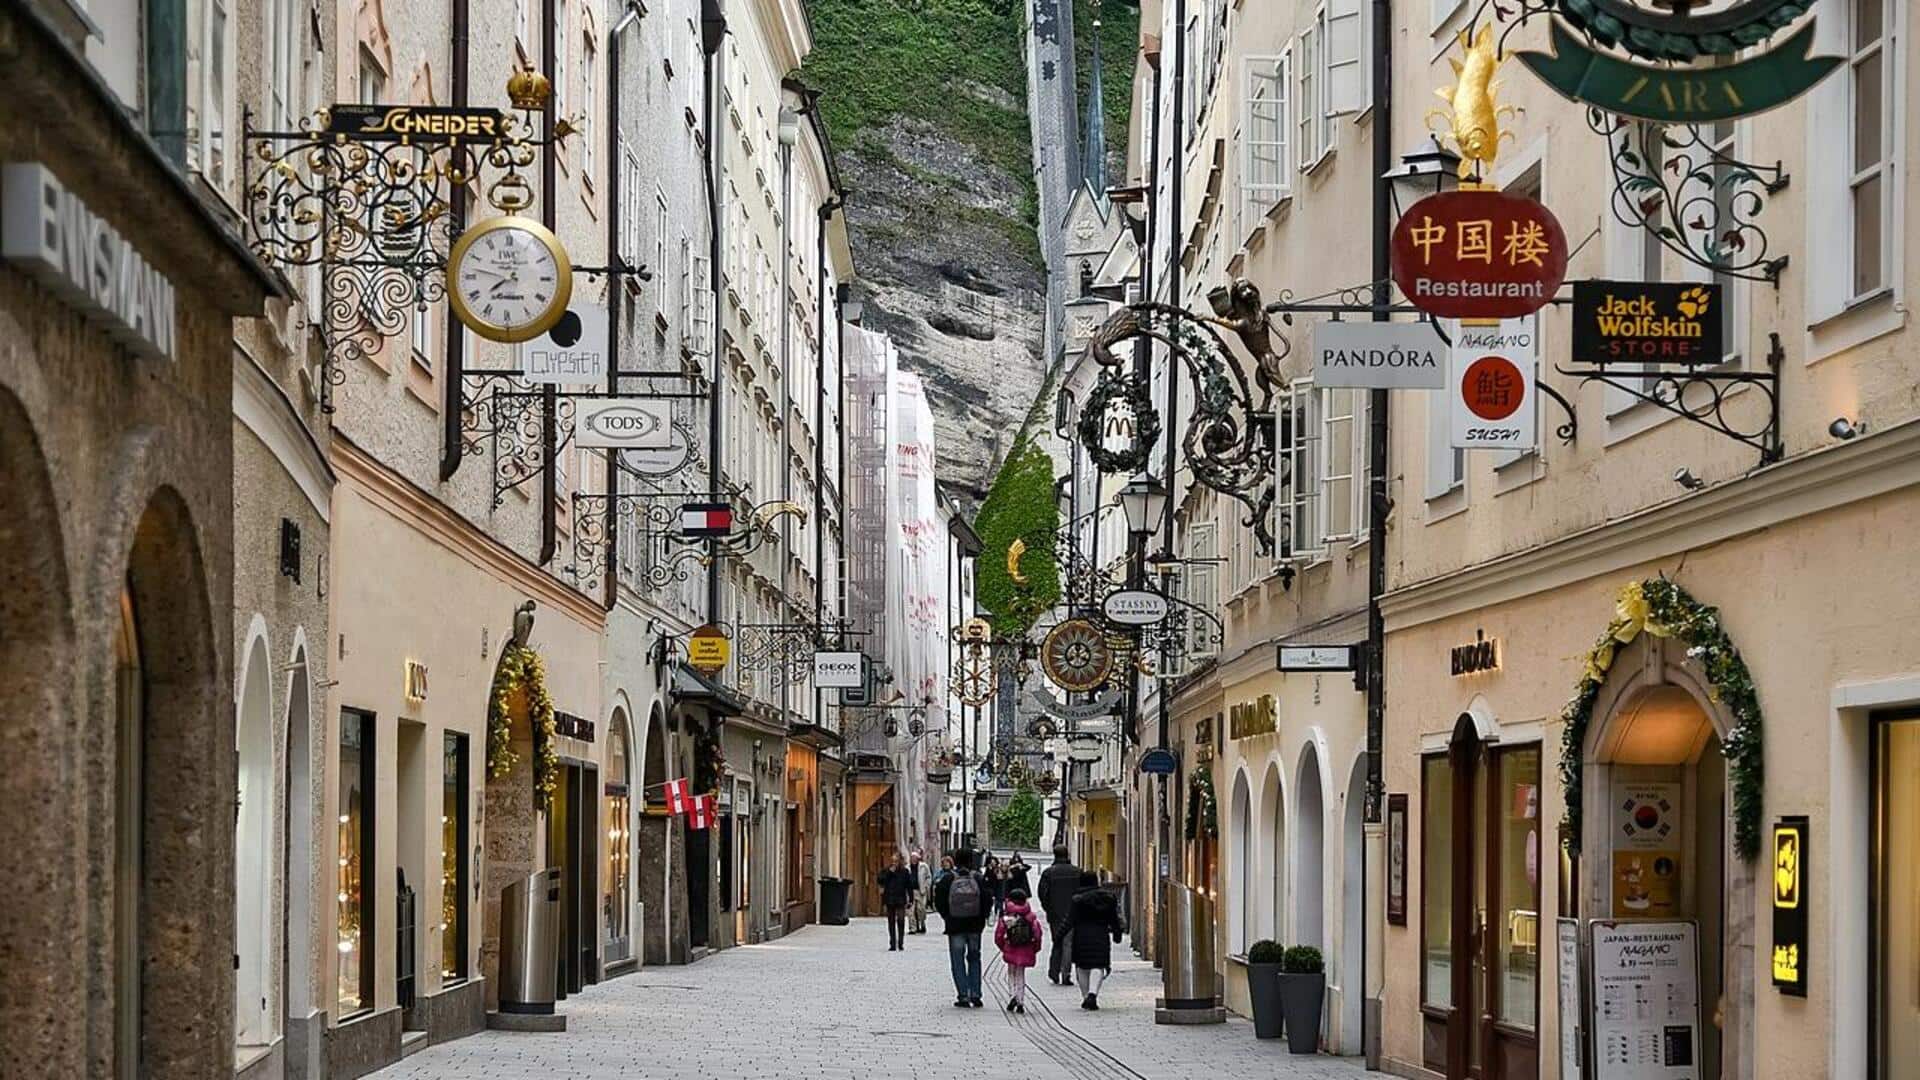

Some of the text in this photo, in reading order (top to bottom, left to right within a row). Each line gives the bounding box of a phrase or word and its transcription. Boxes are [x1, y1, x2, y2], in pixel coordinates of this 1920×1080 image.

[1620, 75, 1744, 112] ZARA
[360, 107, 496, 136] SCHNEIDER
[1409, 215, 1551, 267] 中国楼
[1415, 278, 1544, 297] Restaurant
[1598, 294, 1655, 316] Jack
[1597, 316, 1702, 337] Wolfskin
[1458, 333, 1531, 350] NAGANO
[1323, 345, 1436, 367] PANDORA
[1465, 428, 1521, 442] SUSHI
[1112, 600, 1159, 609] STASSNY
[819, 663, 857, 671] GEOX
[1603, 934, 1686, 943] JAPAN-RESTAURANT
[1619, 945, 1671, 957] NAGANO
